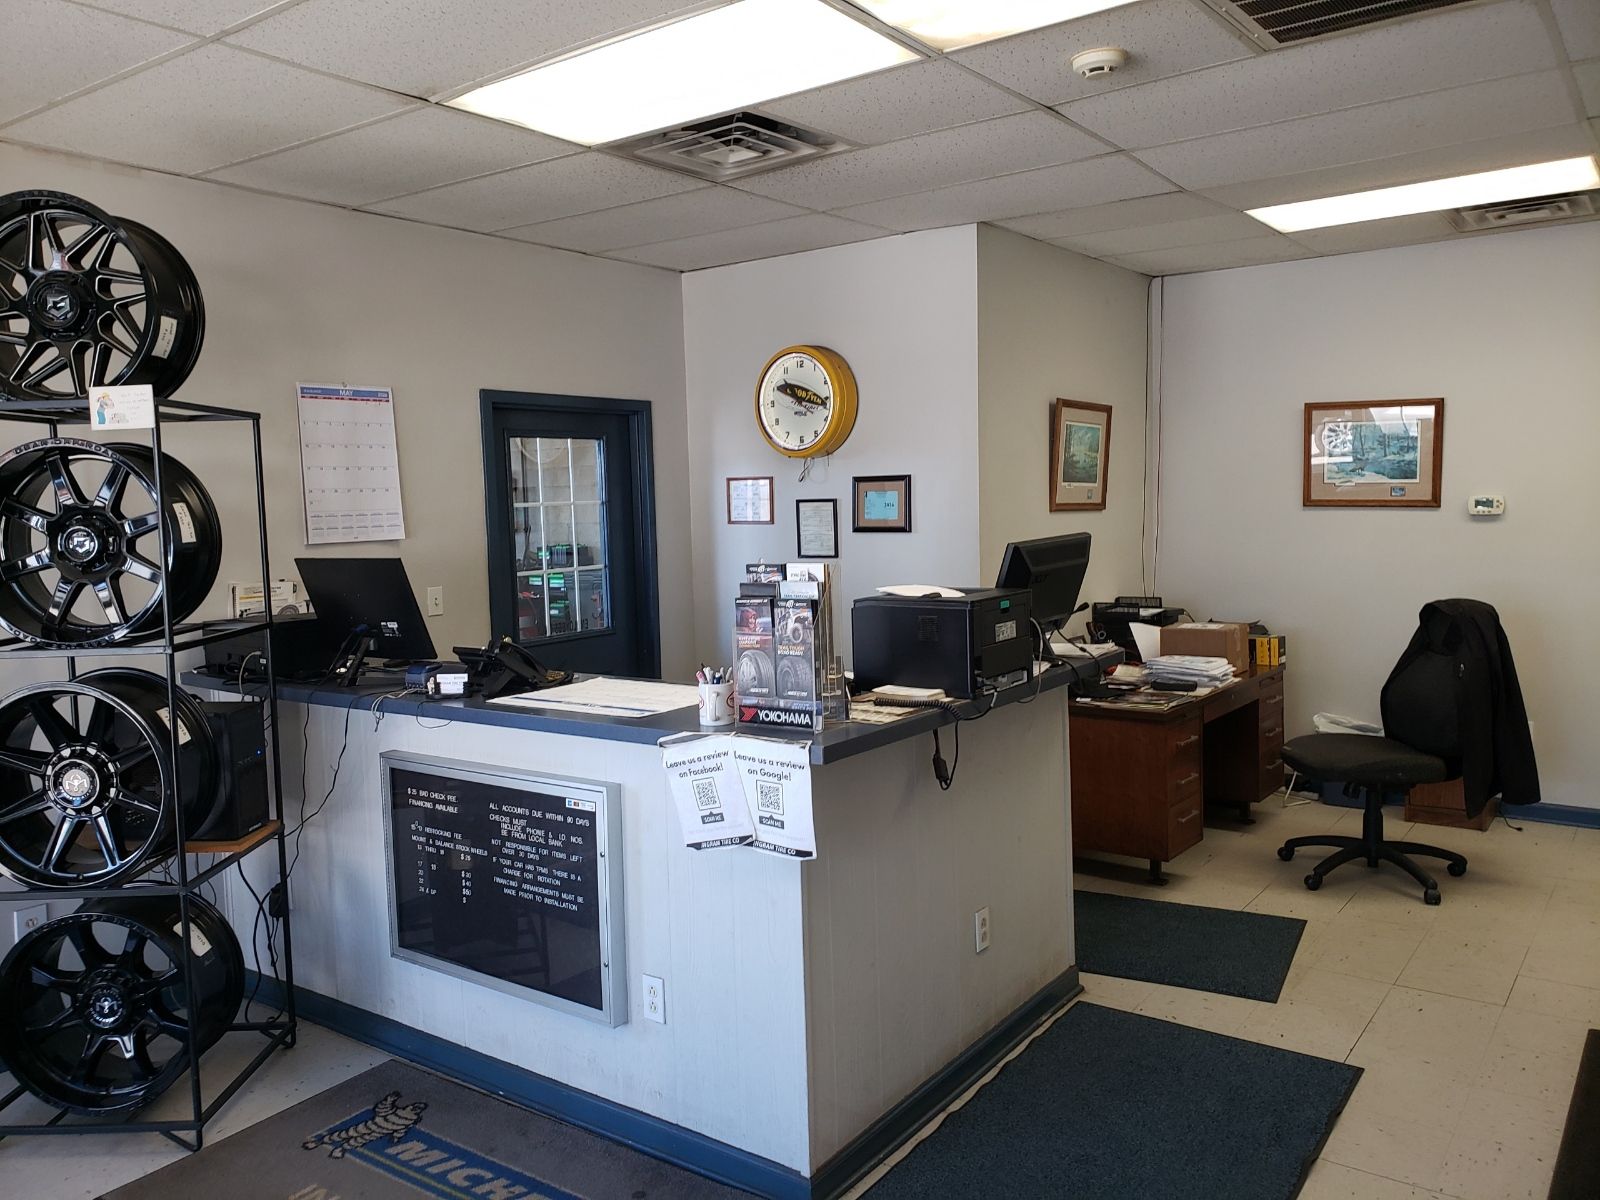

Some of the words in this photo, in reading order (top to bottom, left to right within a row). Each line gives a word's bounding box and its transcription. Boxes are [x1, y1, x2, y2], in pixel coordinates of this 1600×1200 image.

[758, 709, 811, 726] YOKOHAMA
[666, 758, 686, 769] Leave
[703, 750, 729, 760] review
[734, 750, 755, 763] Leave
[776, 761, 805, 770] review
[689, 763, 723, 777] Facebook!
[760, 768, 792, 782] Google!
[409, 799, 433, 809] FINANCING
[435, 804, 458, 813] AVAILABLE
[489, 814, 510, 823] CHECKS
[513, 818, 527, 826] MUST
[502, 804, 529, 816] ACCOUNTS
[532, 810, 543, 818] DUE
[545, 812, 564, 822] WITHIN
[576, 818, 590, 827] DAYS
[500, 823, 522, 833] INCLUDE
[526, 827, 545, 836] PHONE
[412, 834, 426, 842] MOUNT
[435, 840, 455, 849] BALANCE
[456, 844, 470, 852] STOCK
[512, 831, 527, 840] FROM
[528, 834, 546, 844] LOCAL
[548, 839, 563, 847] BANK
[502, 847, 515, 855] OVER
[506, 842, 536, 854] RESPONSIBLE
[539, 848, 549, 856] FOR
[552, 851, 566, 860] ITEMS
[570, 855, 583, 863] LEFT
[499, 857, 512, 866] YOUR
[536, 865, 548, 874] TPMS
[553, 869, 568, 878] THERE
[503, 867, 521, 877] CHARGE
[537, 875, 560, 886] ROTATION
[493, 876, 518, 887] FINANCING
[522, 883, 559, 897] ARRANGEMENTS
[562, 892, 575, 901] MUST
[503, 888, 517, 896] MADE
[519, 891, 534, 900] PRIOR
[544, 897, 578, 911] INSTALLATION
